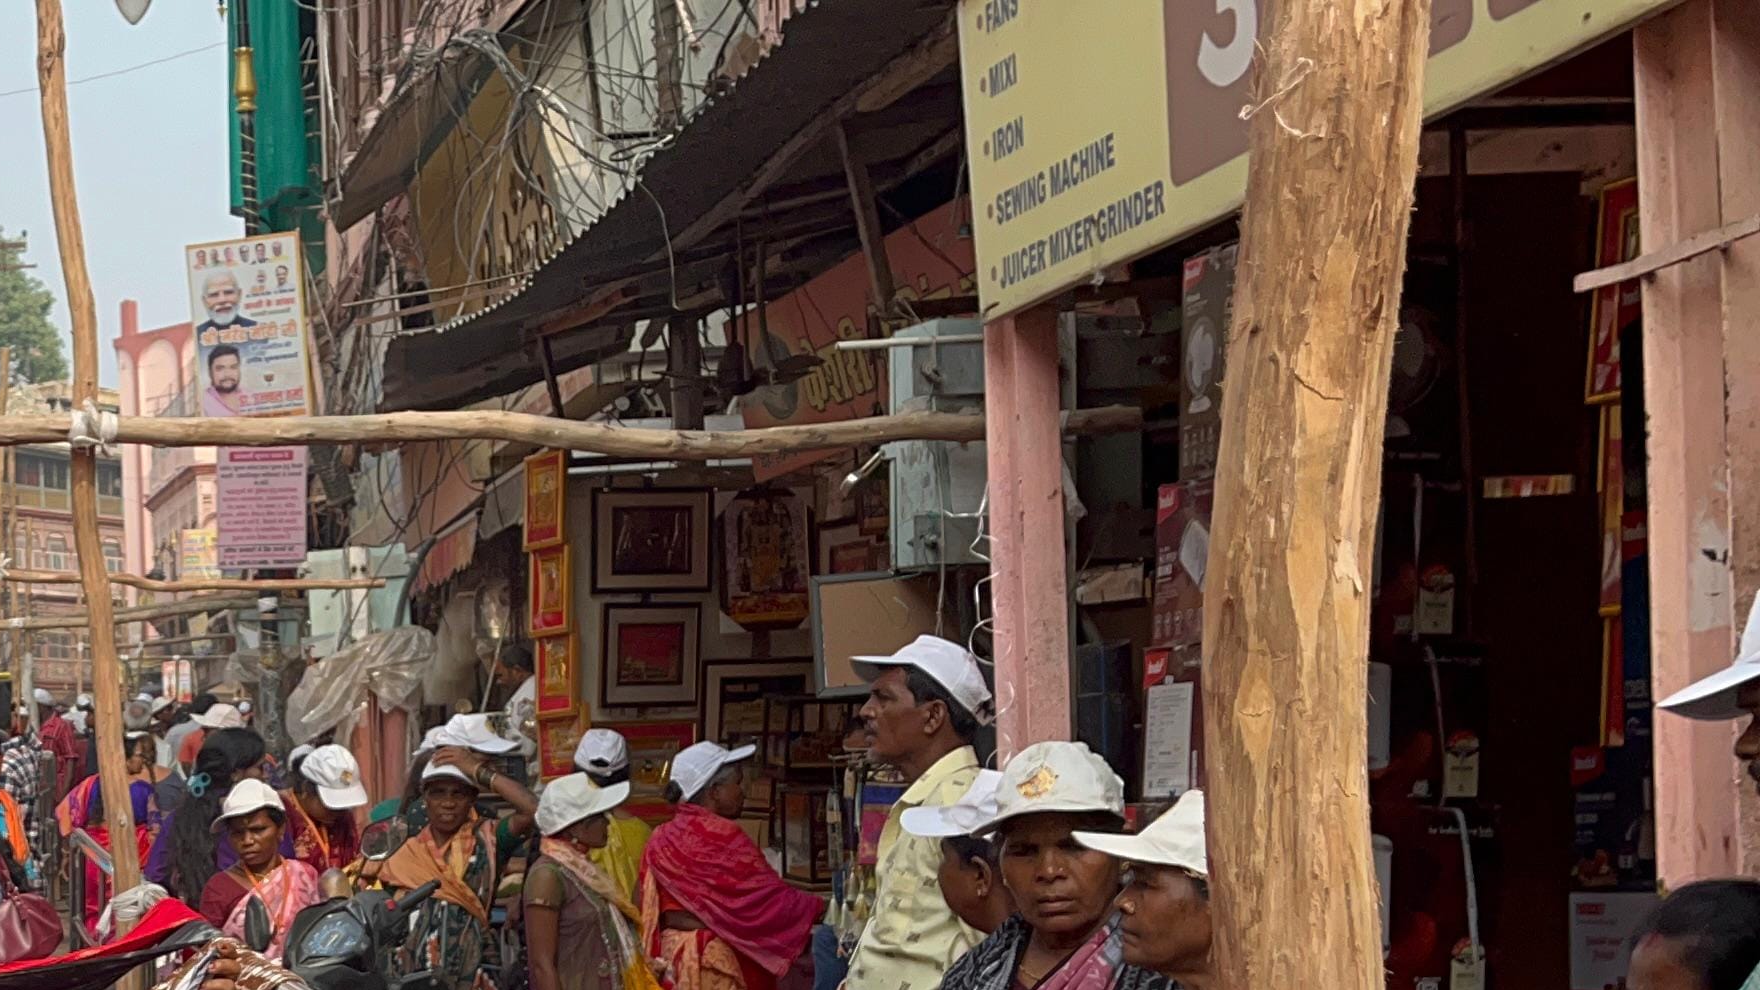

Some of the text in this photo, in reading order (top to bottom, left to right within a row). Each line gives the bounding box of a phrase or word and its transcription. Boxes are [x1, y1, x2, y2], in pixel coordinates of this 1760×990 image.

[985, 0, 1019, 33] FANS
[988, 52, 1018, 99] MIXI
[992, 115, 1025, 163] IRON
[996, 131, 1116, 226] SEWING MACHINE
[1000, 179, 1166, 289] JUICER MIXER GRINDER
